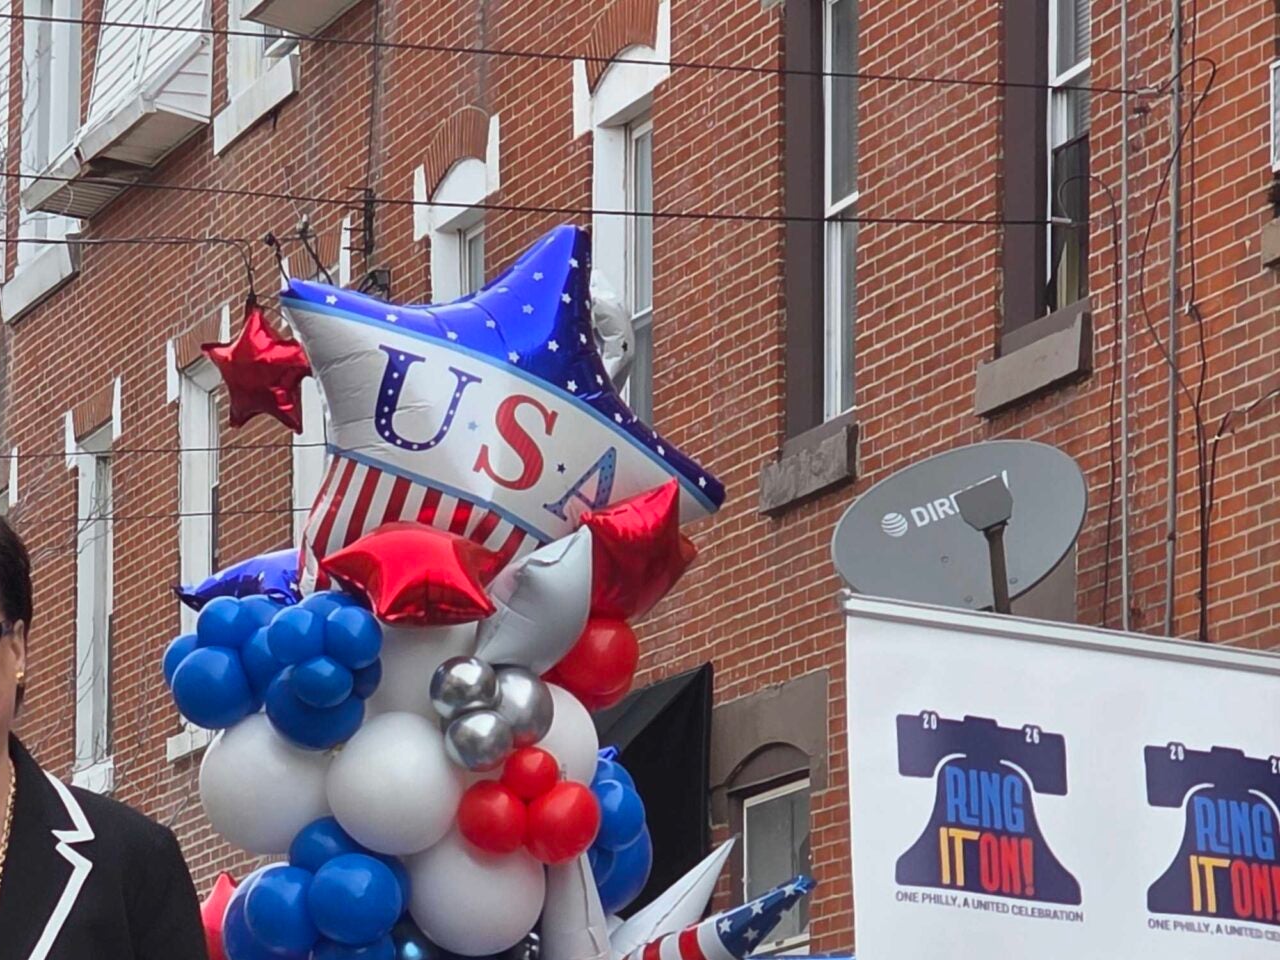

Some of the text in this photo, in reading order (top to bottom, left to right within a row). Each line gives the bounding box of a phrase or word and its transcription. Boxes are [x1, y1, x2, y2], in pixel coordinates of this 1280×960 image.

[374, 344, 617, 522] USA
[922, 713, 1040, 744] 20 26
[1170, 745, 1185, 761] 20
[945, 766, 1025, 833] RING
[1193, 795, 1276, 860] RING
[939, 827, 1035, 896] IT ON!
[1189, 855, 1231, 913] IT
[895, 890, 1084, 922] ONE PHILLY, A UNITED CELEBRATION
[1148, 918, 1172, 932] ONE
[1173, 920, 1214, 936] PHILLY,
[1215, 923, 1223, 935] A
[1225, 925, 1263, 939] UNITED
